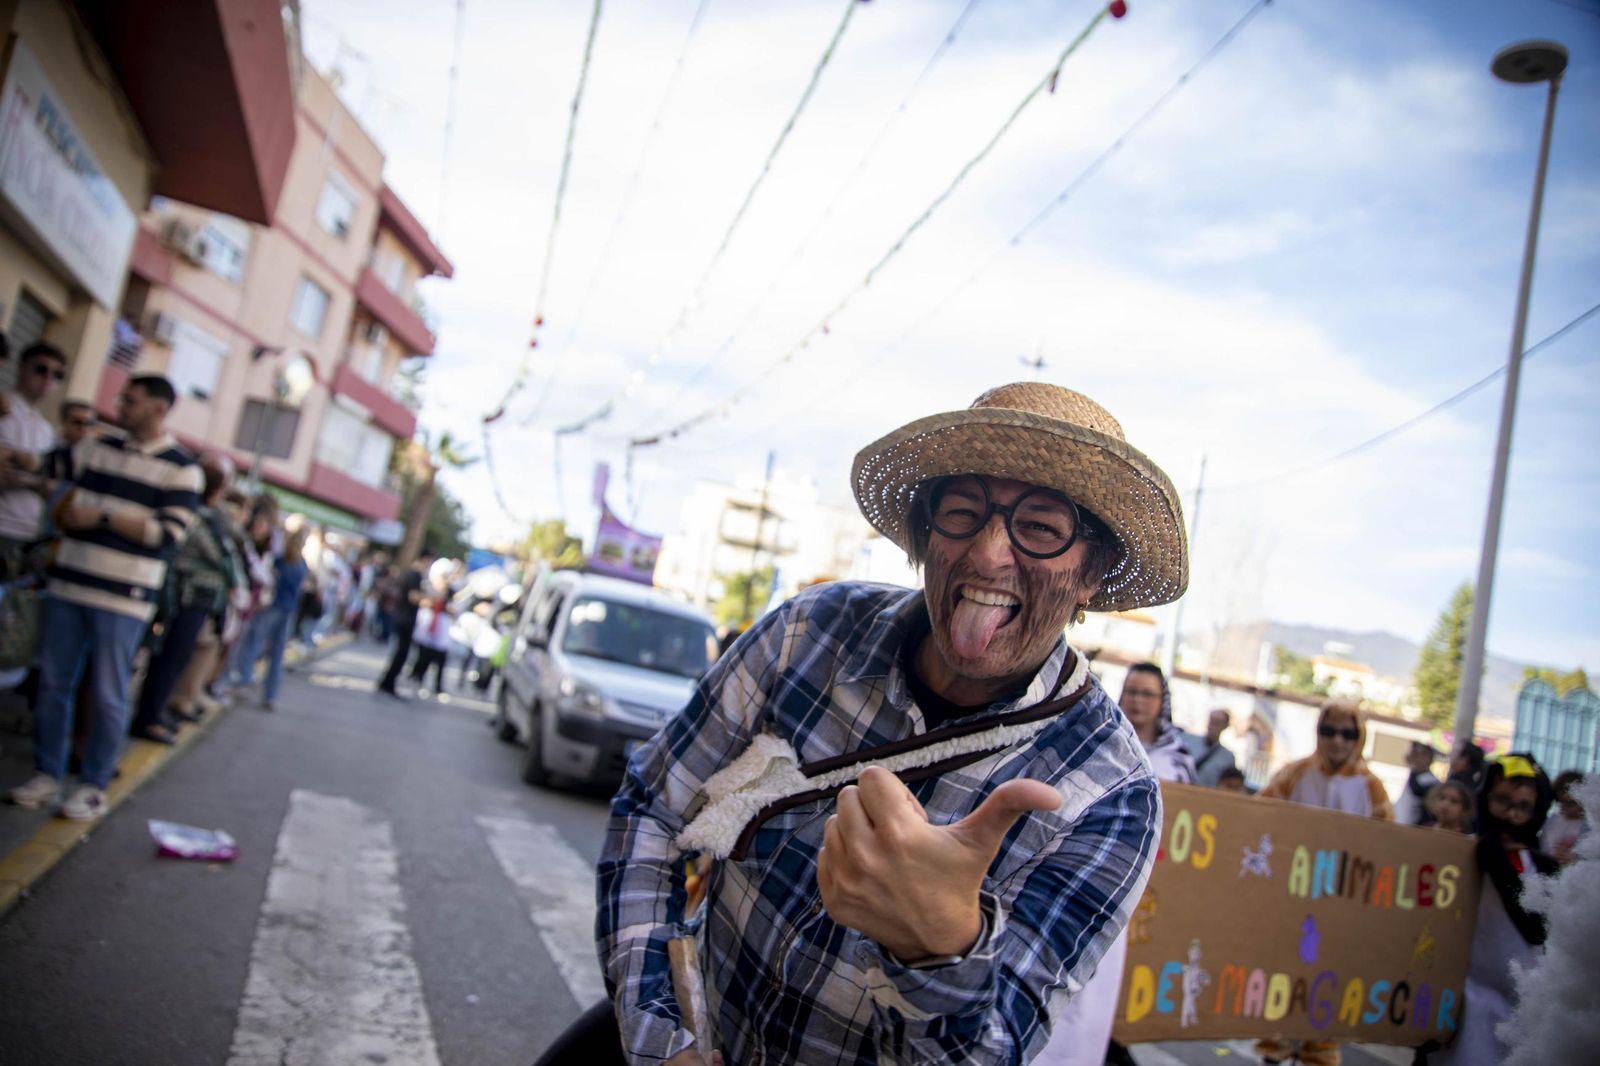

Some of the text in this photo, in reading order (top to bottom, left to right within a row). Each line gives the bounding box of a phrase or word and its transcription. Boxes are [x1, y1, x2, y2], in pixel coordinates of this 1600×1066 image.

[1156, 809, 1461, 908] OS ANIMALES
[1125, 961, 1457, 1030] DE MADAGASCAR
